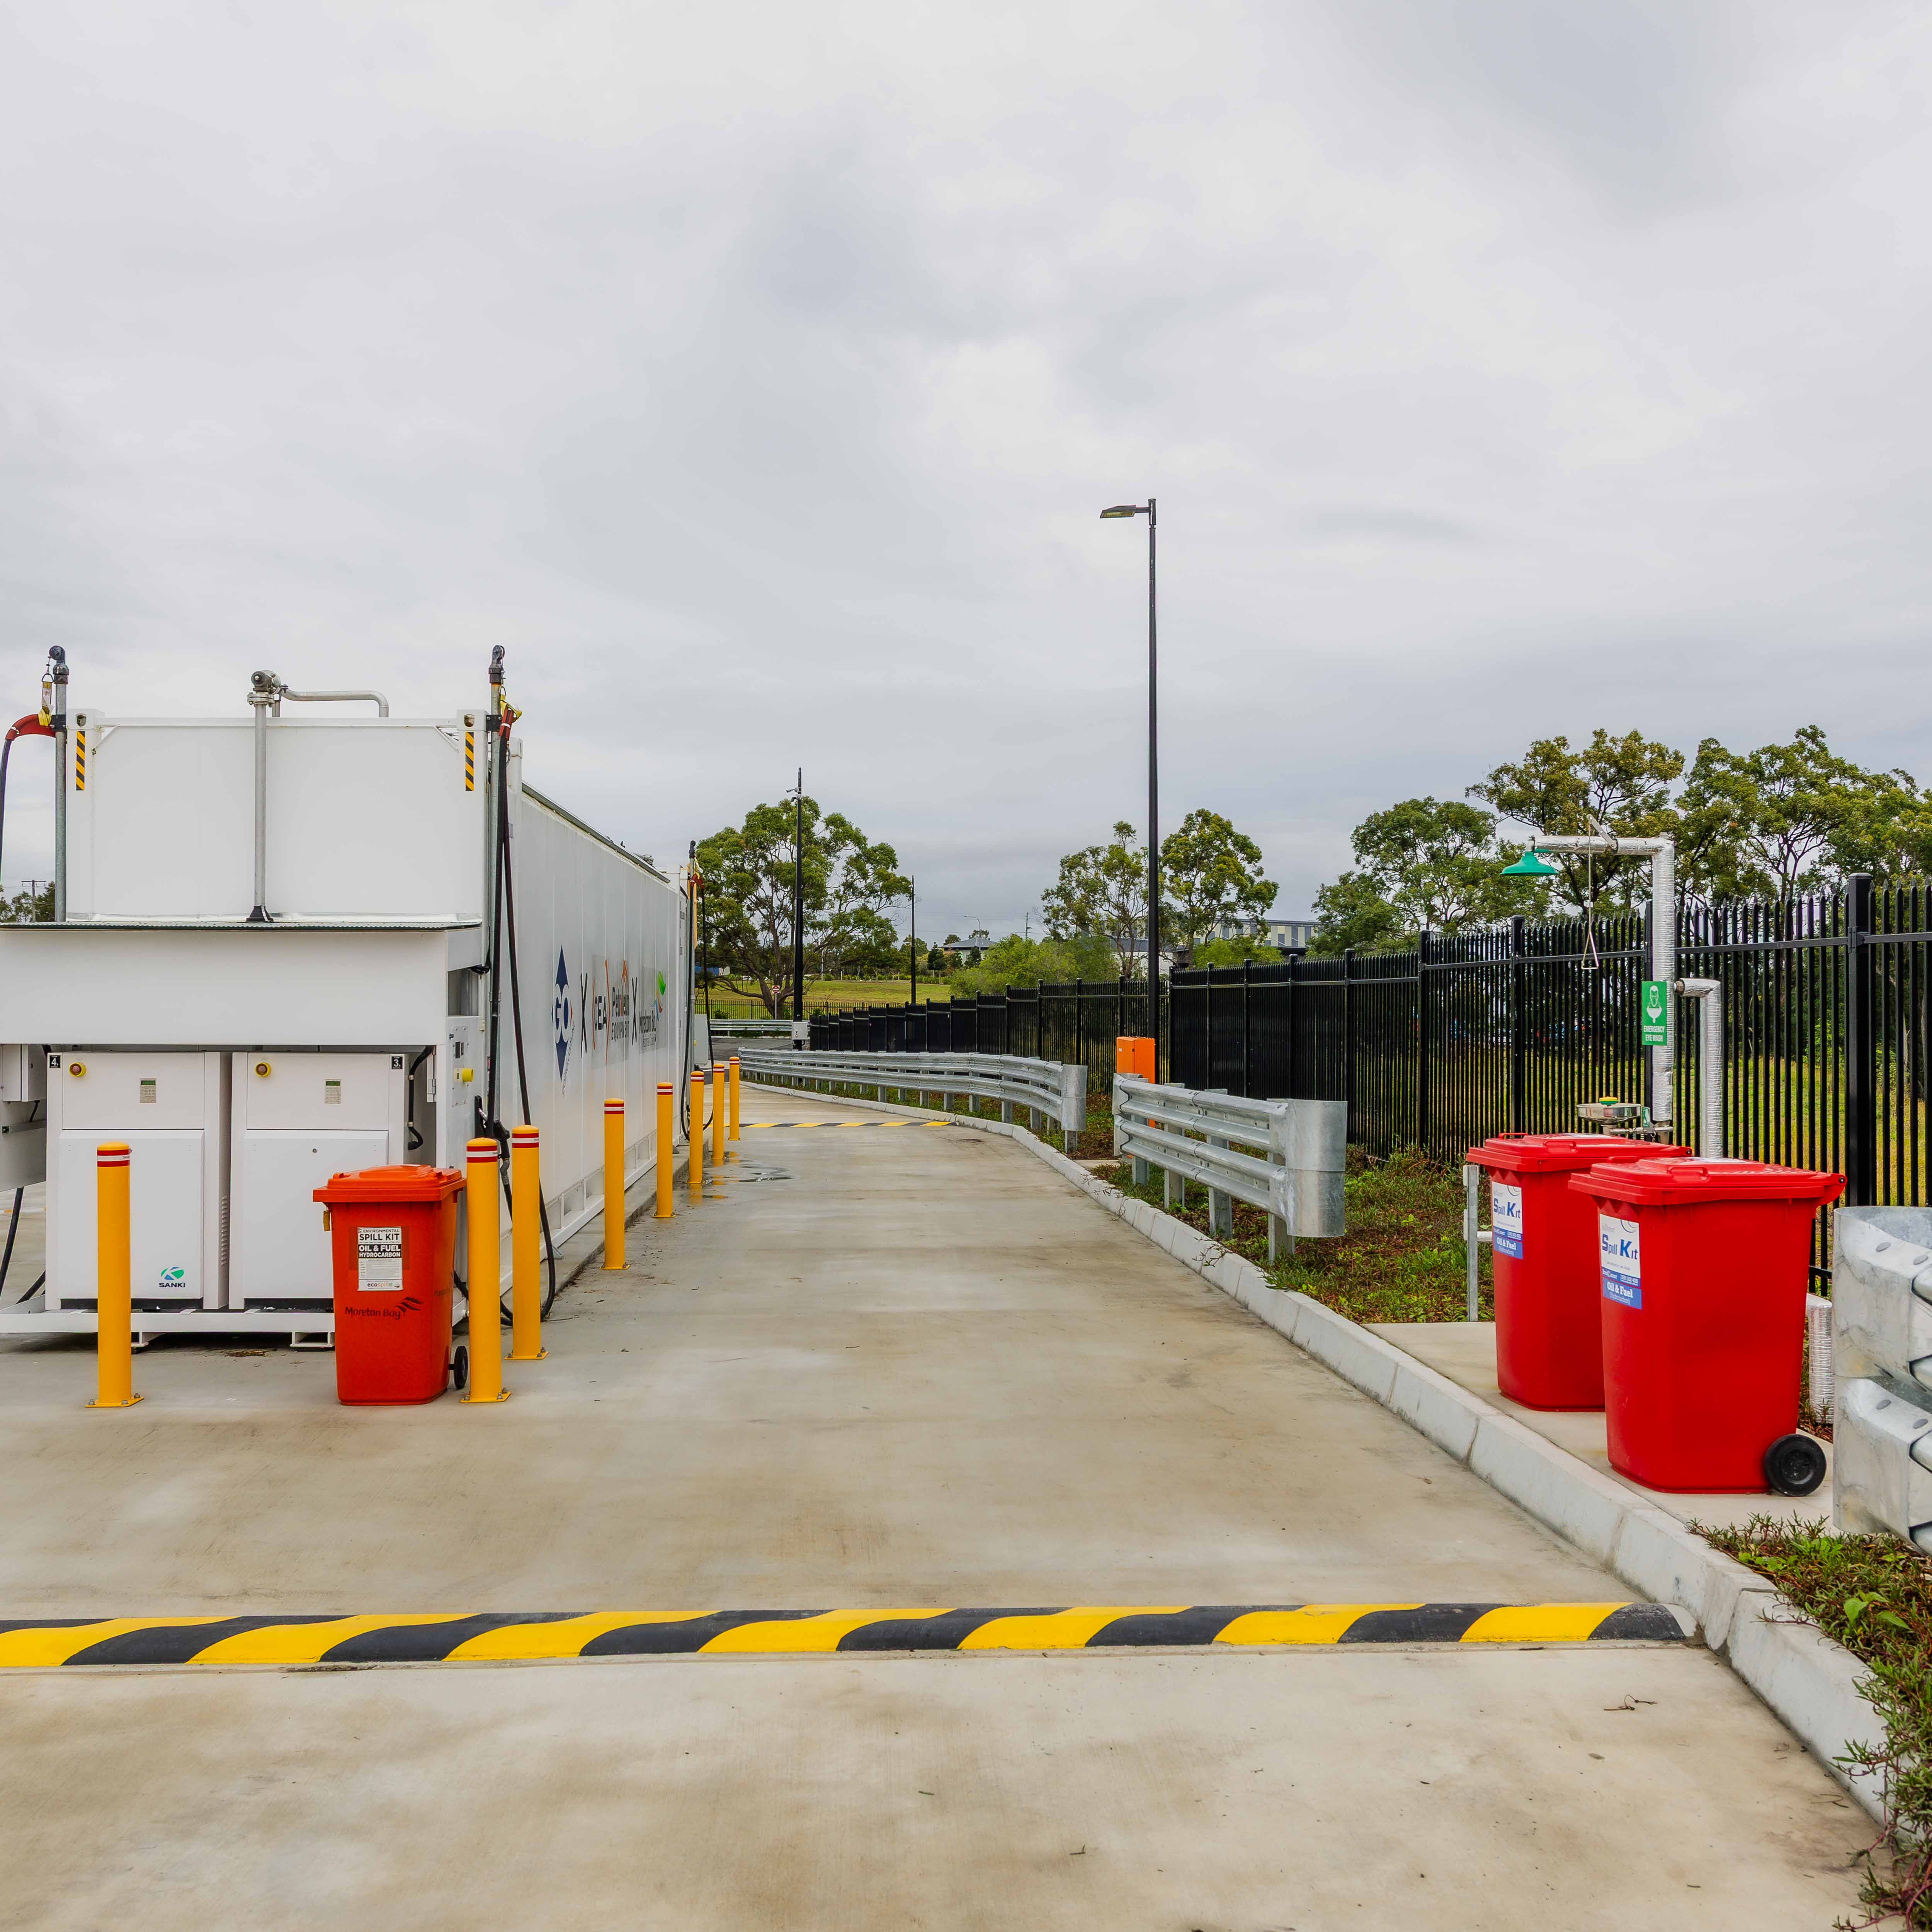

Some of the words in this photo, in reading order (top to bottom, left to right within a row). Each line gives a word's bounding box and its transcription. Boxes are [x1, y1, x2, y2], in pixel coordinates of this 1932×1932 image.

[594, 995, 607, 1031] CEA
[1494, 1198, 1505, 1215] Spill
[1507, 1201, 1520, 1218] Kit
[1602, 1234, 1617, 1255] Spill
[1620, 1239, 1638, 1260] Kit
[1615, 1284, 1619, 1294] &
[1619, 1286, 1633, 1298] Fuel
[345, 1306, 381, 1318] Moreton
[383, 1309, 401, 1320] Bay
